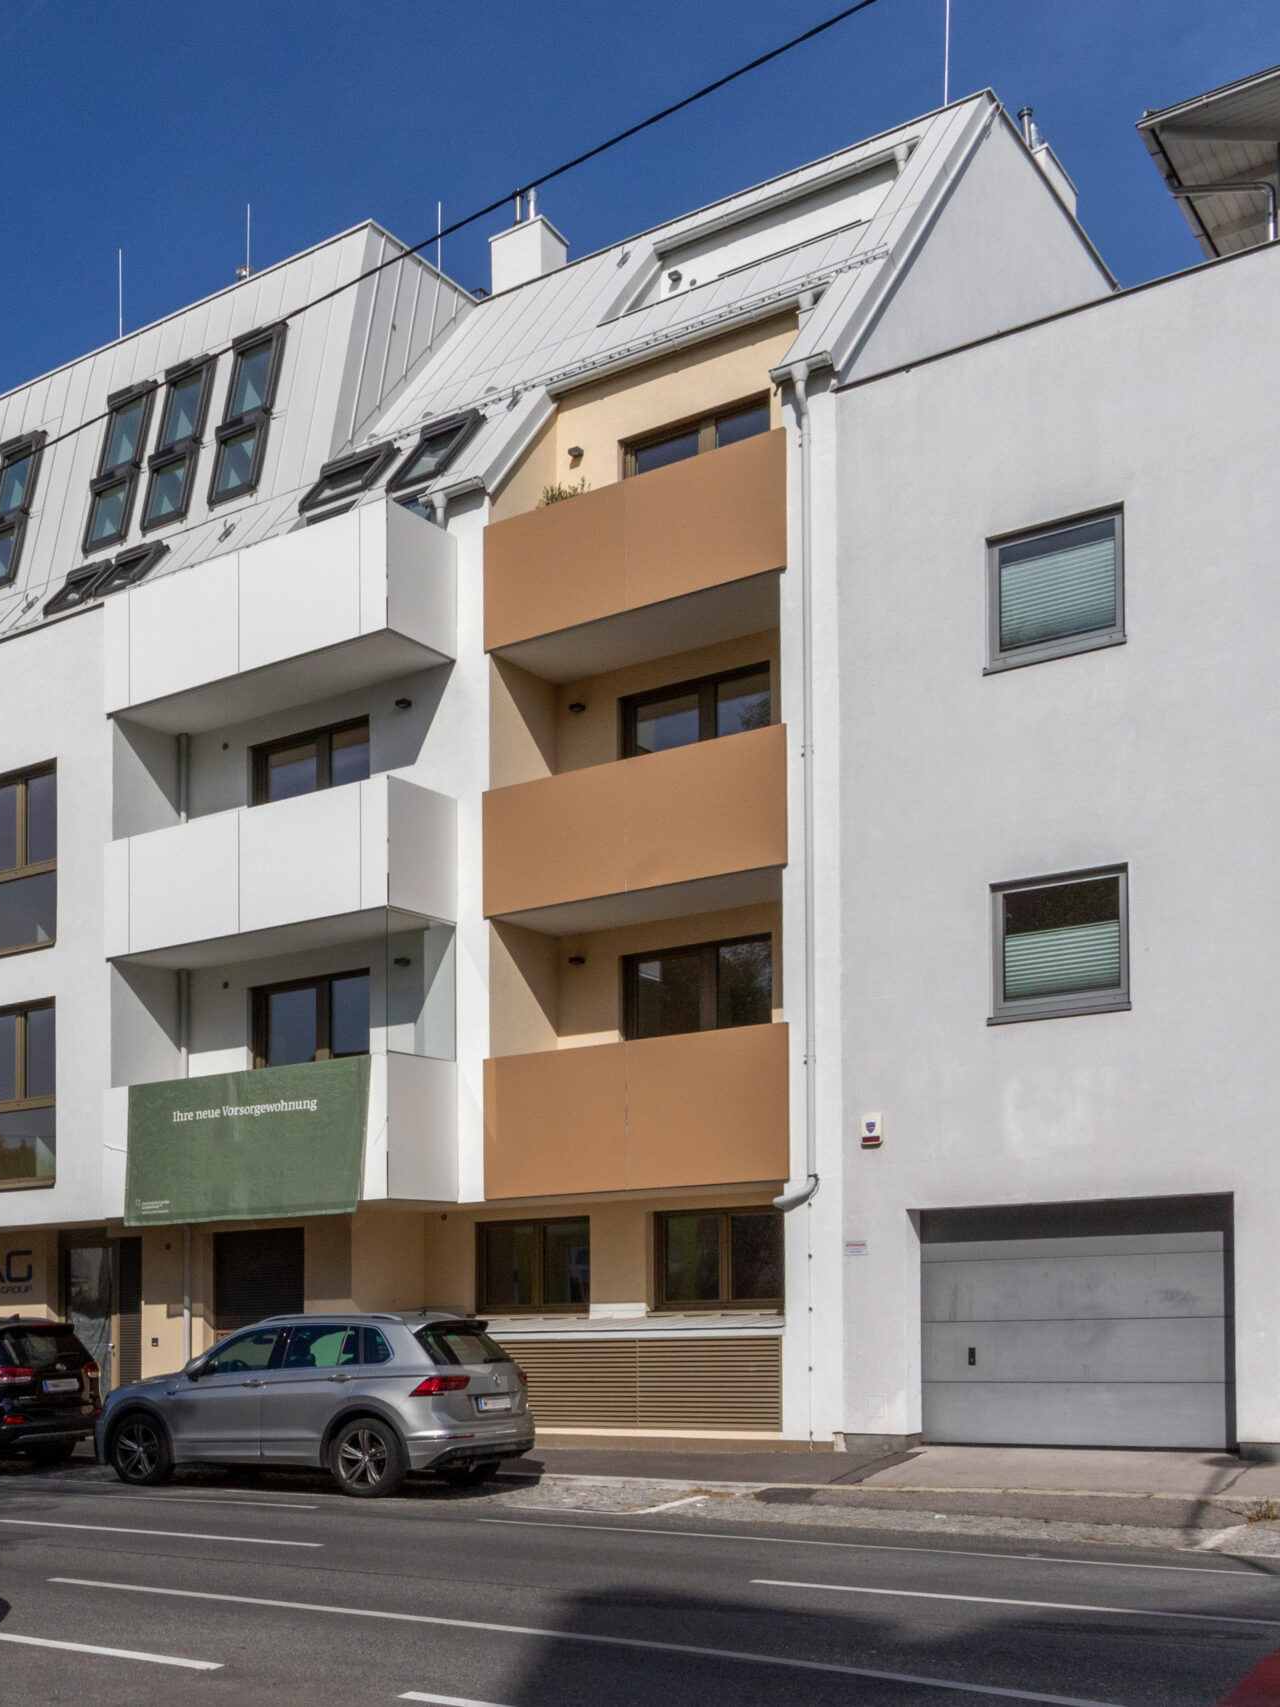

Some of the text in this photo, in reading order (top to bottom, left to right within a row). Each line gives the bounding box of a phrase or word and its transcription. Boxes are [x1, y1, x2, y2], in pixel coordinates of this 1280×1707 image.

[172, 1099, 318, 1122] Ihre neue Vorsorgewohnung
[0, 1285, 33, 1295] GROUP
